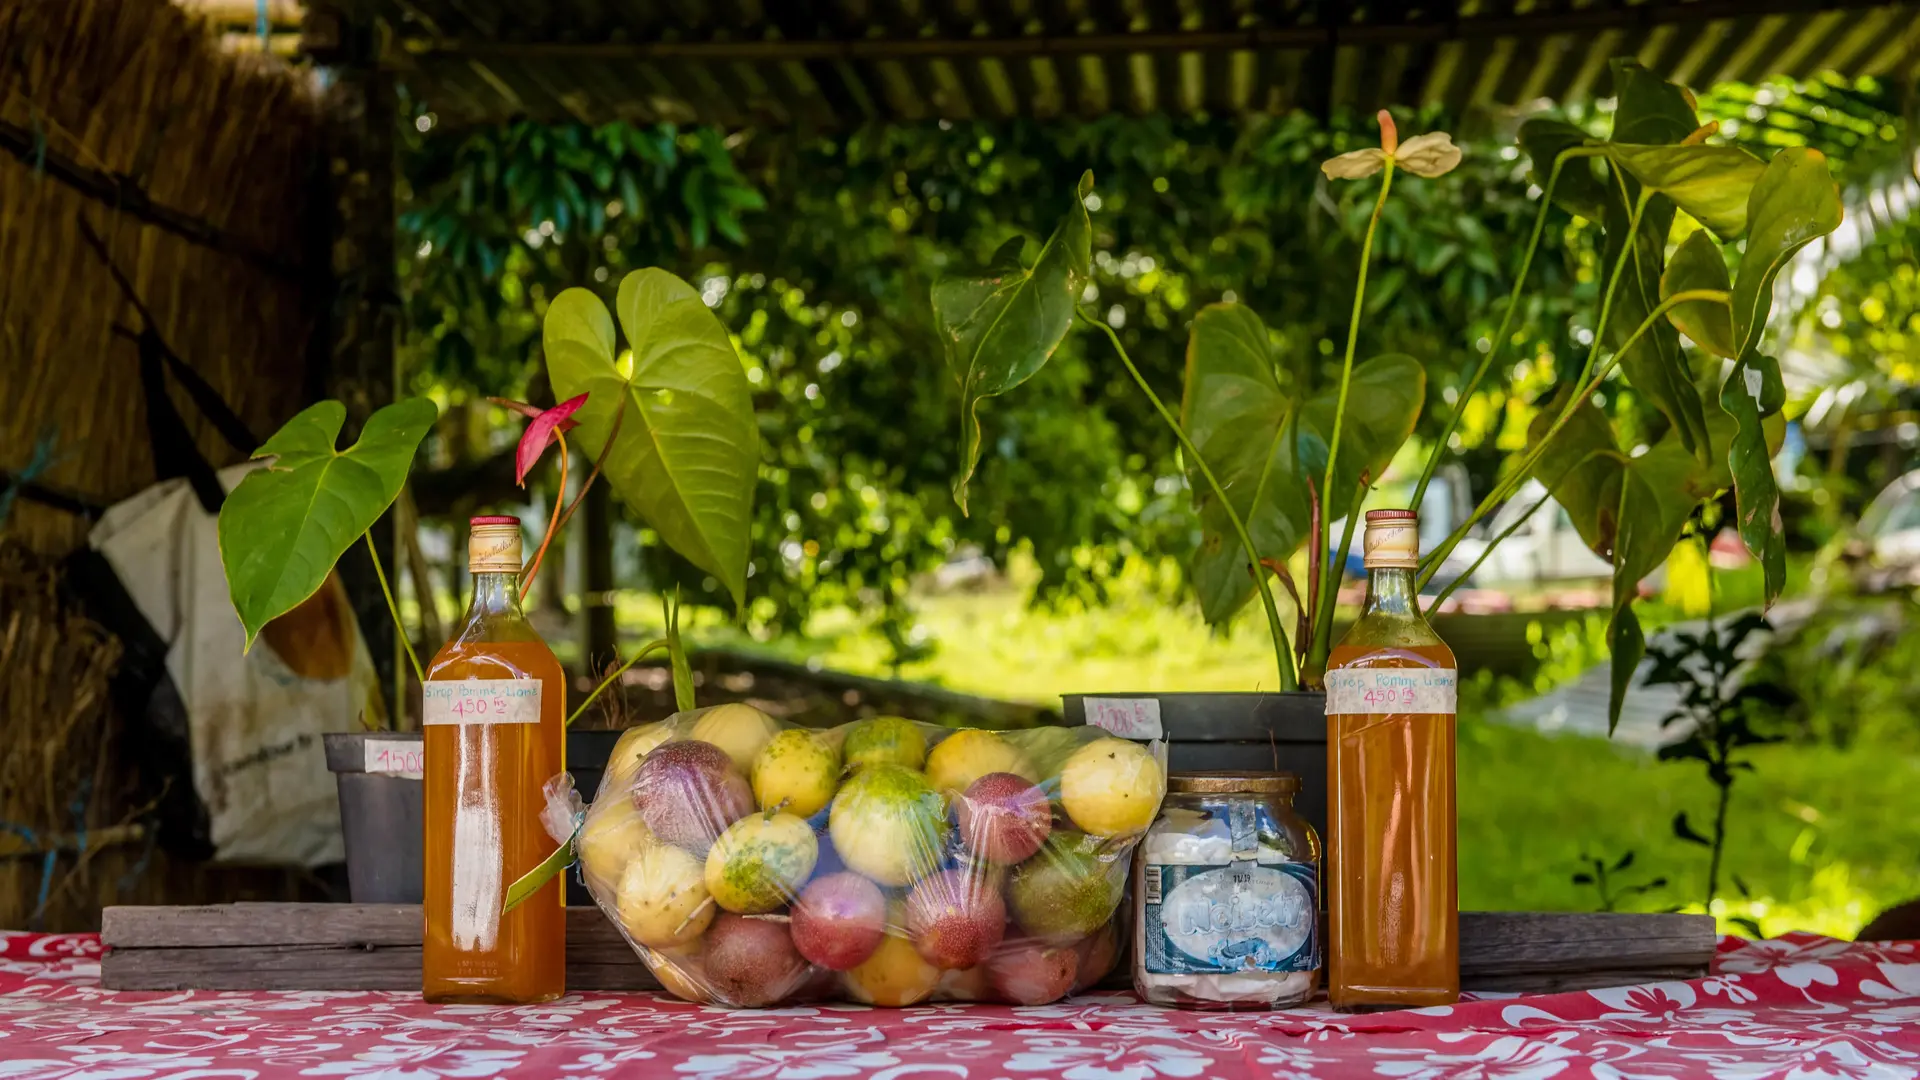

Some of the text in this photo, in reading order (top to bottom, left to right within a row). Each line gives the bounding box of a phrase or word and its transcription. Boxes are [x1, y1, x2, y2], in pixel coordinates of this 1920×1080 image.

[425, 684, 454, 702] Sirop
[1329, 672, 1365, 694] Sirop
[1375, 673, 1417, 690] Pomme
[1363, 688, 1396, 708] 450
[451, 699, 488, 719] 450
